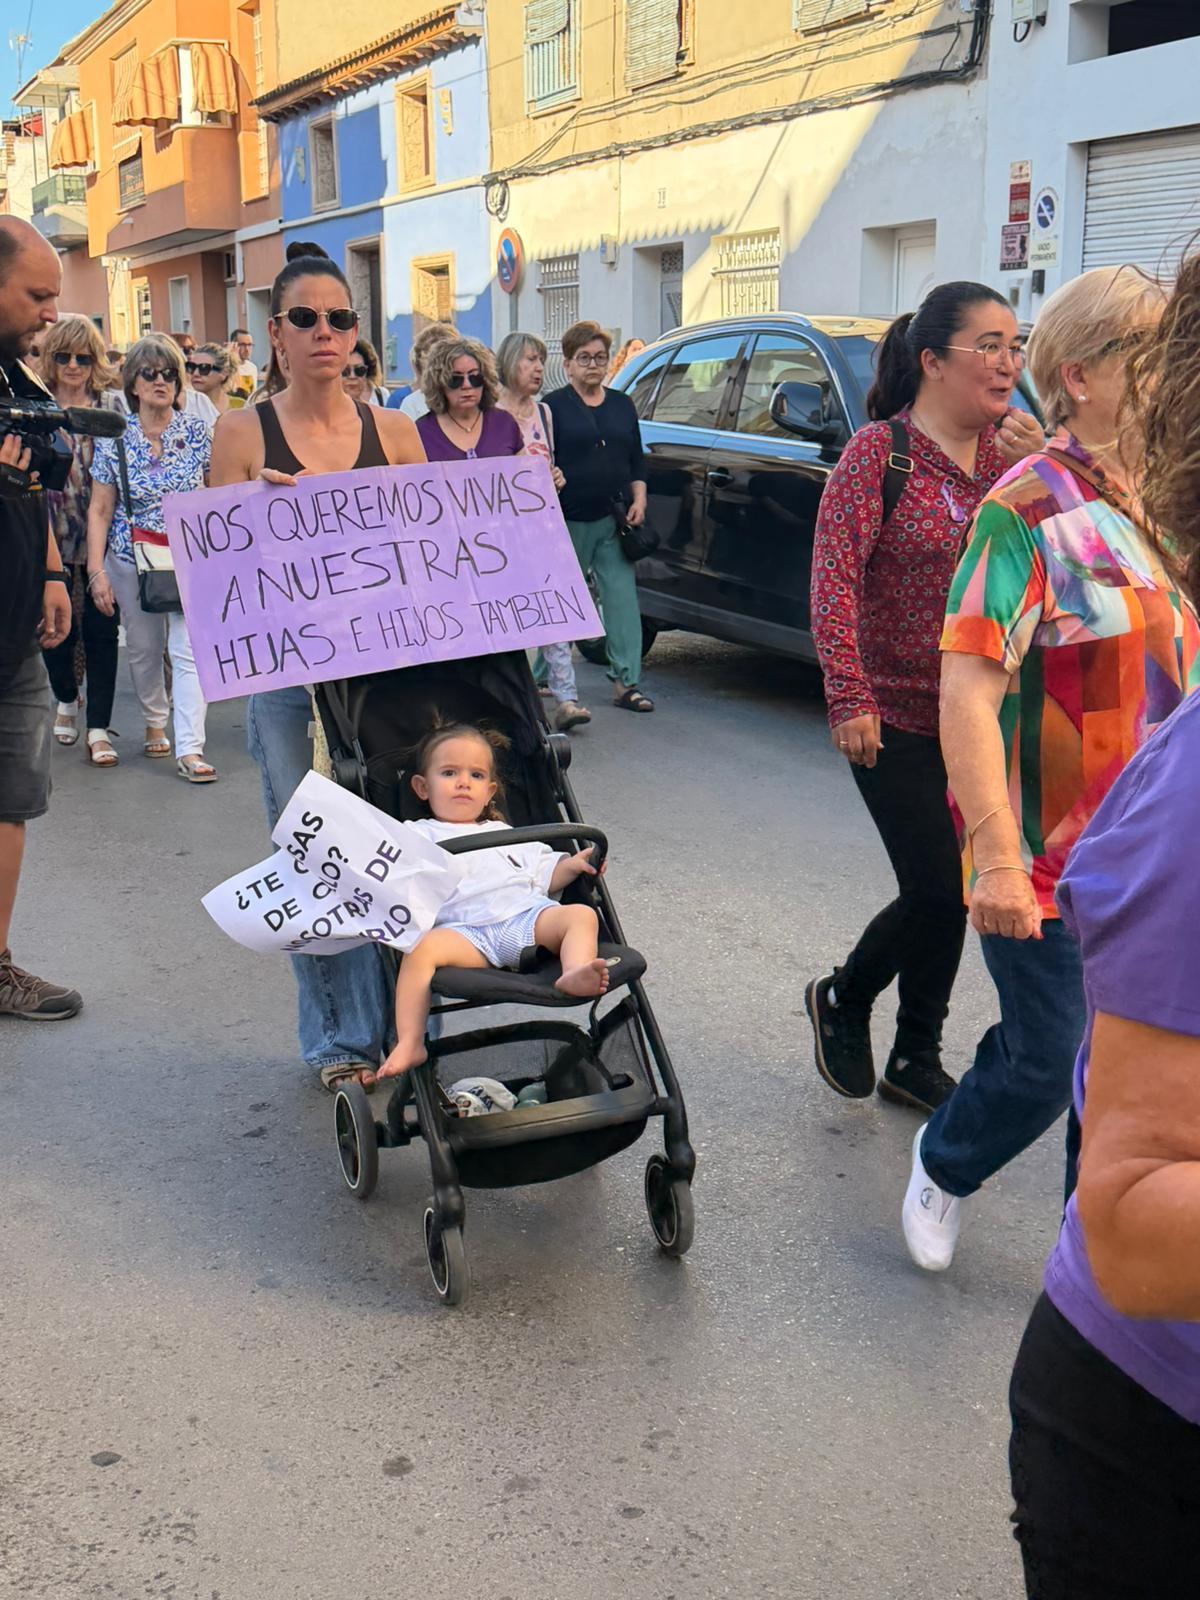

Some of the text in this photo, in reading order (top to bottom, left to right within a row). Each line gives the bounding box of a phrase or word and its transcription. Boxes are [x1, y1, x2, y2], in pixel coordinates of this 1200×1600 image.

[1037, 242, 1051, 251] VADO
[180, 470, 555, 562] NOS QUEREMOS VIVAS.
[221, 532, 508, 623] A NUESTRAS
[214, 574, 586, 685] HIJAS E HIJOS TAMBIÉN
[364, 839, 402, 883] DE
[235, 871, 284, 911] ¿TE
[263, 898, 302, 932] DE
